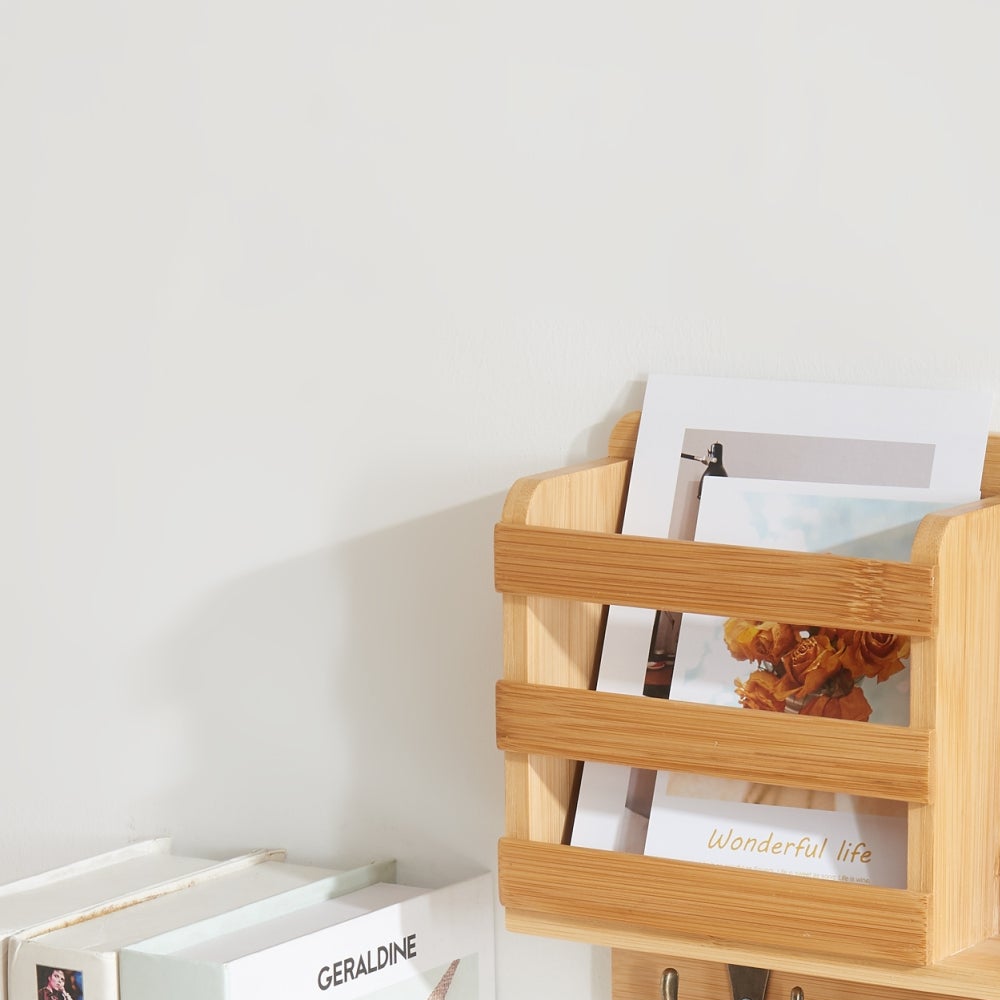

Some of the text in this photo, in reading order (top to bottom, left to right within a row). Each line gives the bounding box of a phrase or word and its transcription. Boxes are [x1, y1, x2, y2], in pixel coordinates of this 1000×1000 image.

[707, 828, 872, 864] Wonderful life
[318, 934, 416, 991] GERALDINE
